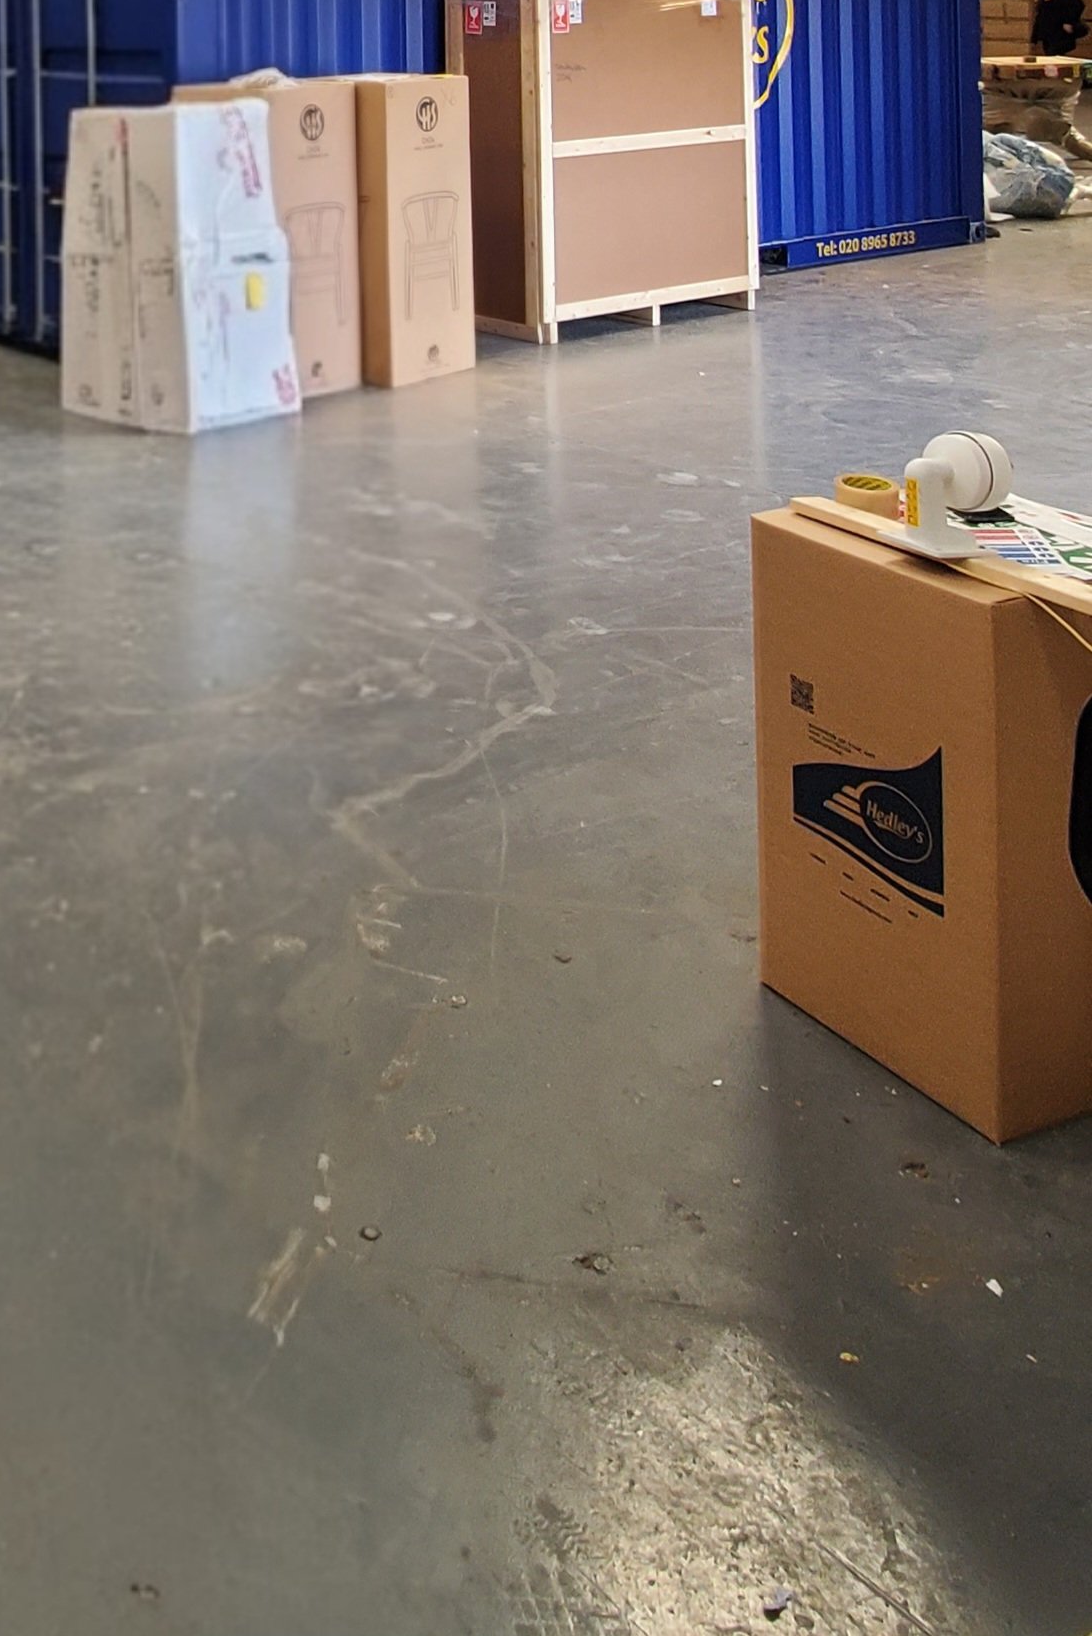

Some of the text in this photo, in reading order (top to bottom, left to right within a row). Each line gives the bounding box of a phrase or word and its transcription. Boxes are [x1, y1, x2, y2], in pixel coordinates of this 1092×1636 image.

[816, 229, 916, 257] Tel: 020 8965 8733
[866, 799, 925, 844] Hedley's
